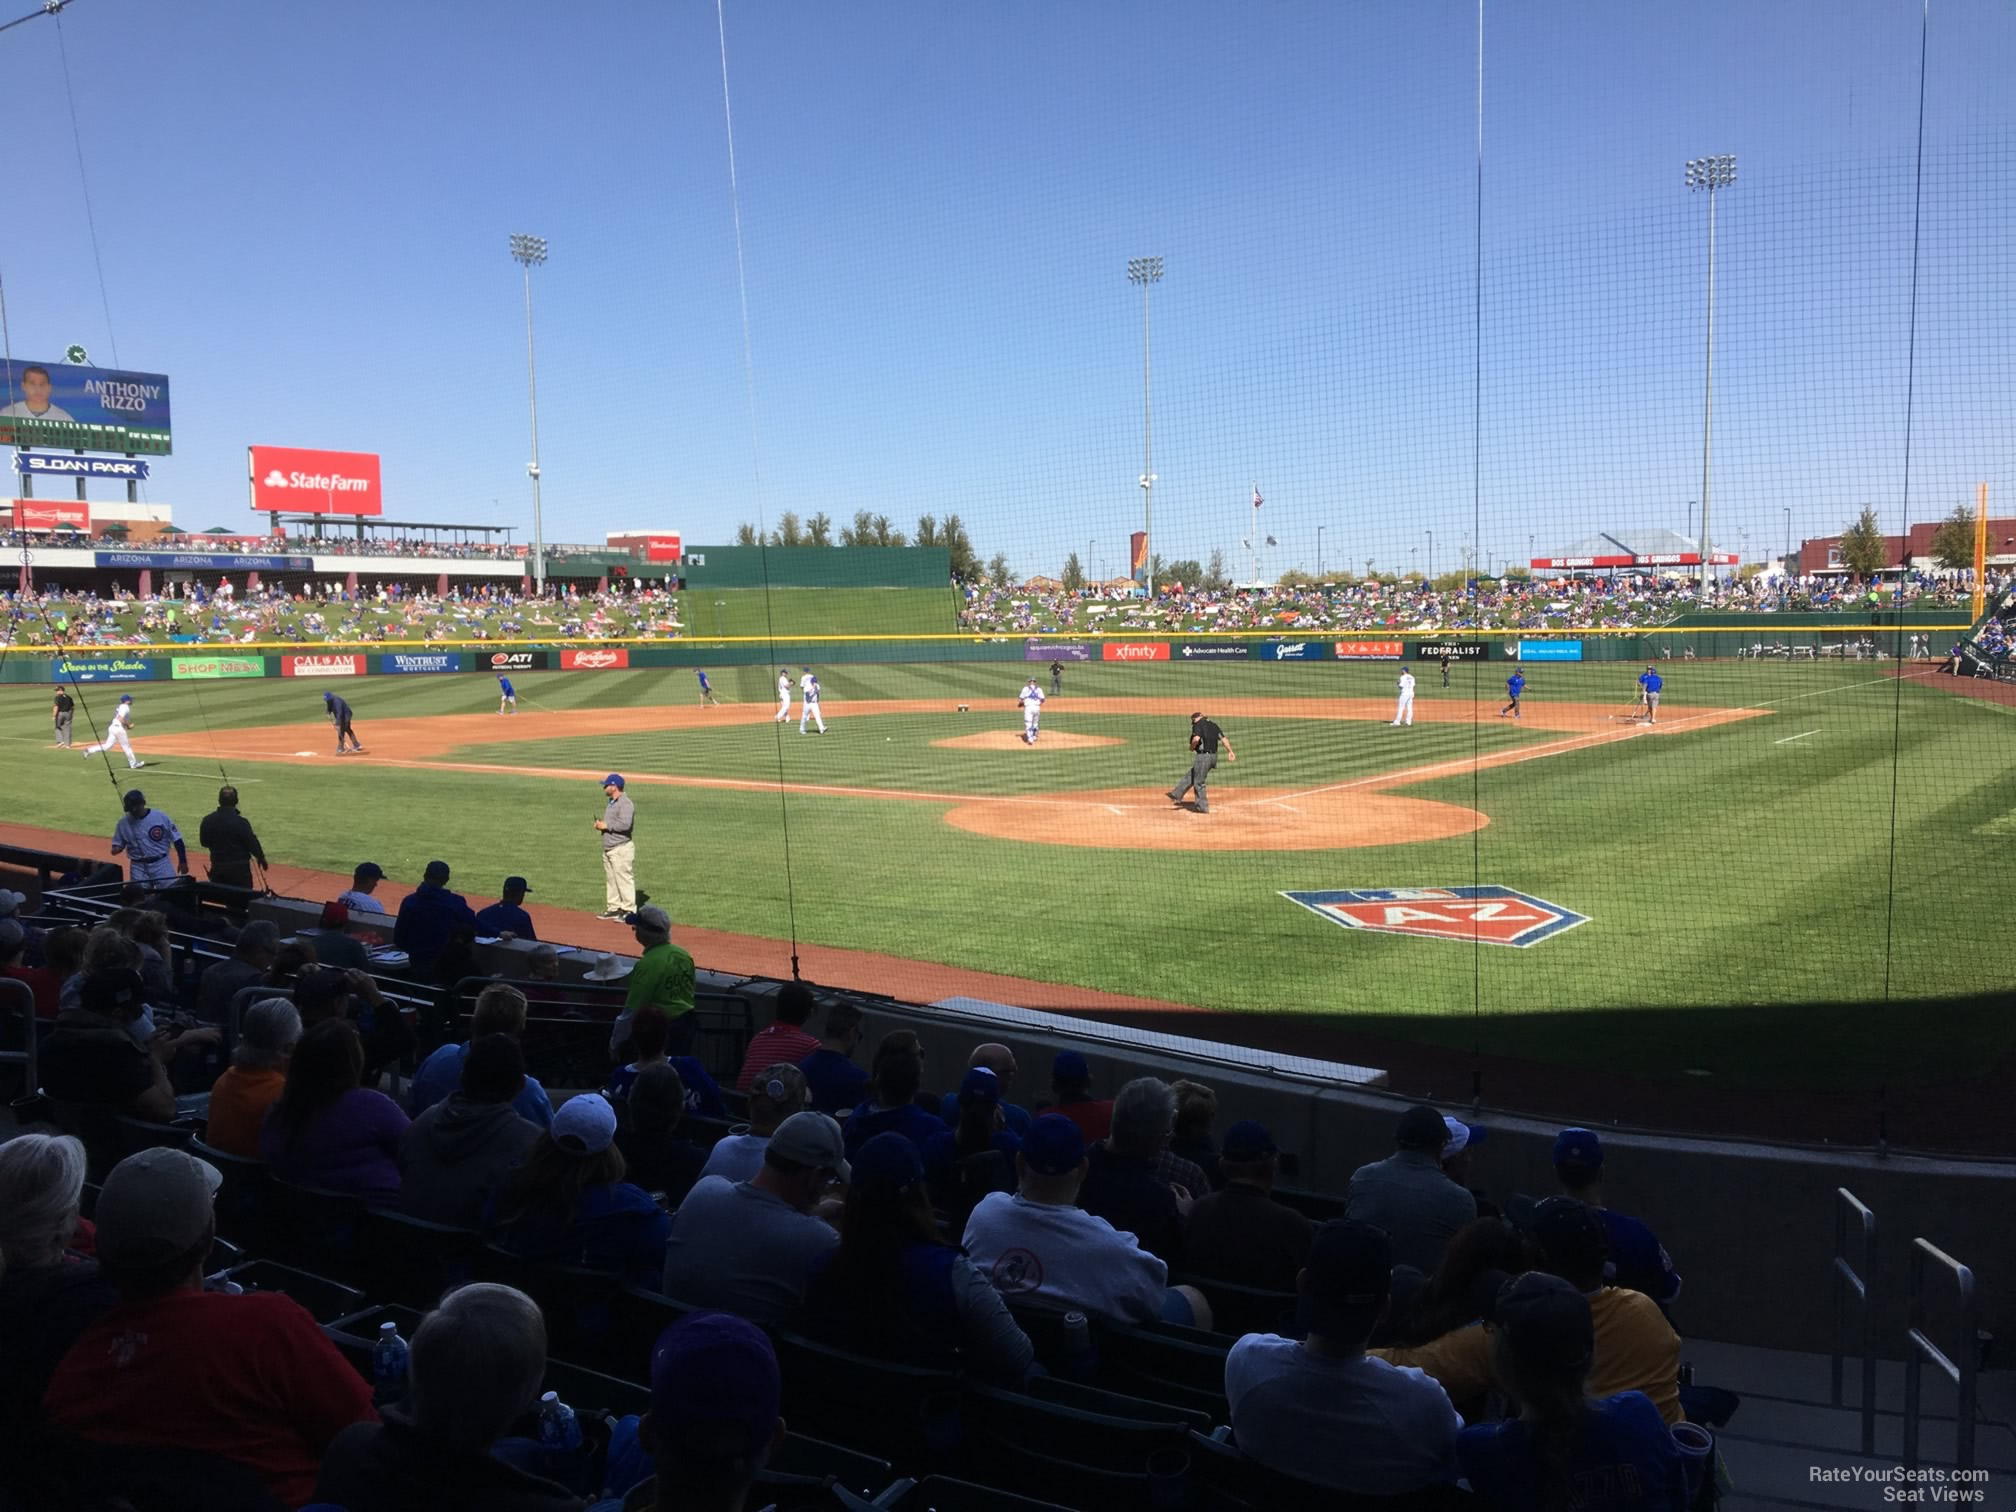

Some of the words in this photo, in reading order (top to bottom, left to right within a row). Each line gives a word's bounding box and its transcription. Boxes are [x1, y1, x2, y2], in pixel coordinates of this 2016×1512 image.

[84, 378, 160, 400] ANTHONY
[101, 394, 146, 411] RIZZO
[29, 458, 89, 472] SLOAN
[92, 461, 137, 474] PARK
[109, 554, 152, 564] ARIZONA
[173, 556, 213, 566] ARIZONA
[233, 557, 272, 566] ARIZONA
[1551, 558, 1565, 567] DOS
[1566, 557, 1594, 567] GRINGOS
[1636, 556, 1650, 565] DOS
[1651, 554, 1681, 564] GRINGOS
[1116, 643, 1157, 660] xfinity
[1421, 647, 1480, 655] FEDERALIST
[294, 655, 322, 666] CAL
[333, 655, 355, 666] AM
[508, 653, 533, 663] ATI
[178, 663, 217, 674] SHOP
[220, 662, 261, 673] MESA
[1384, 903, 1539, 926] AZ
